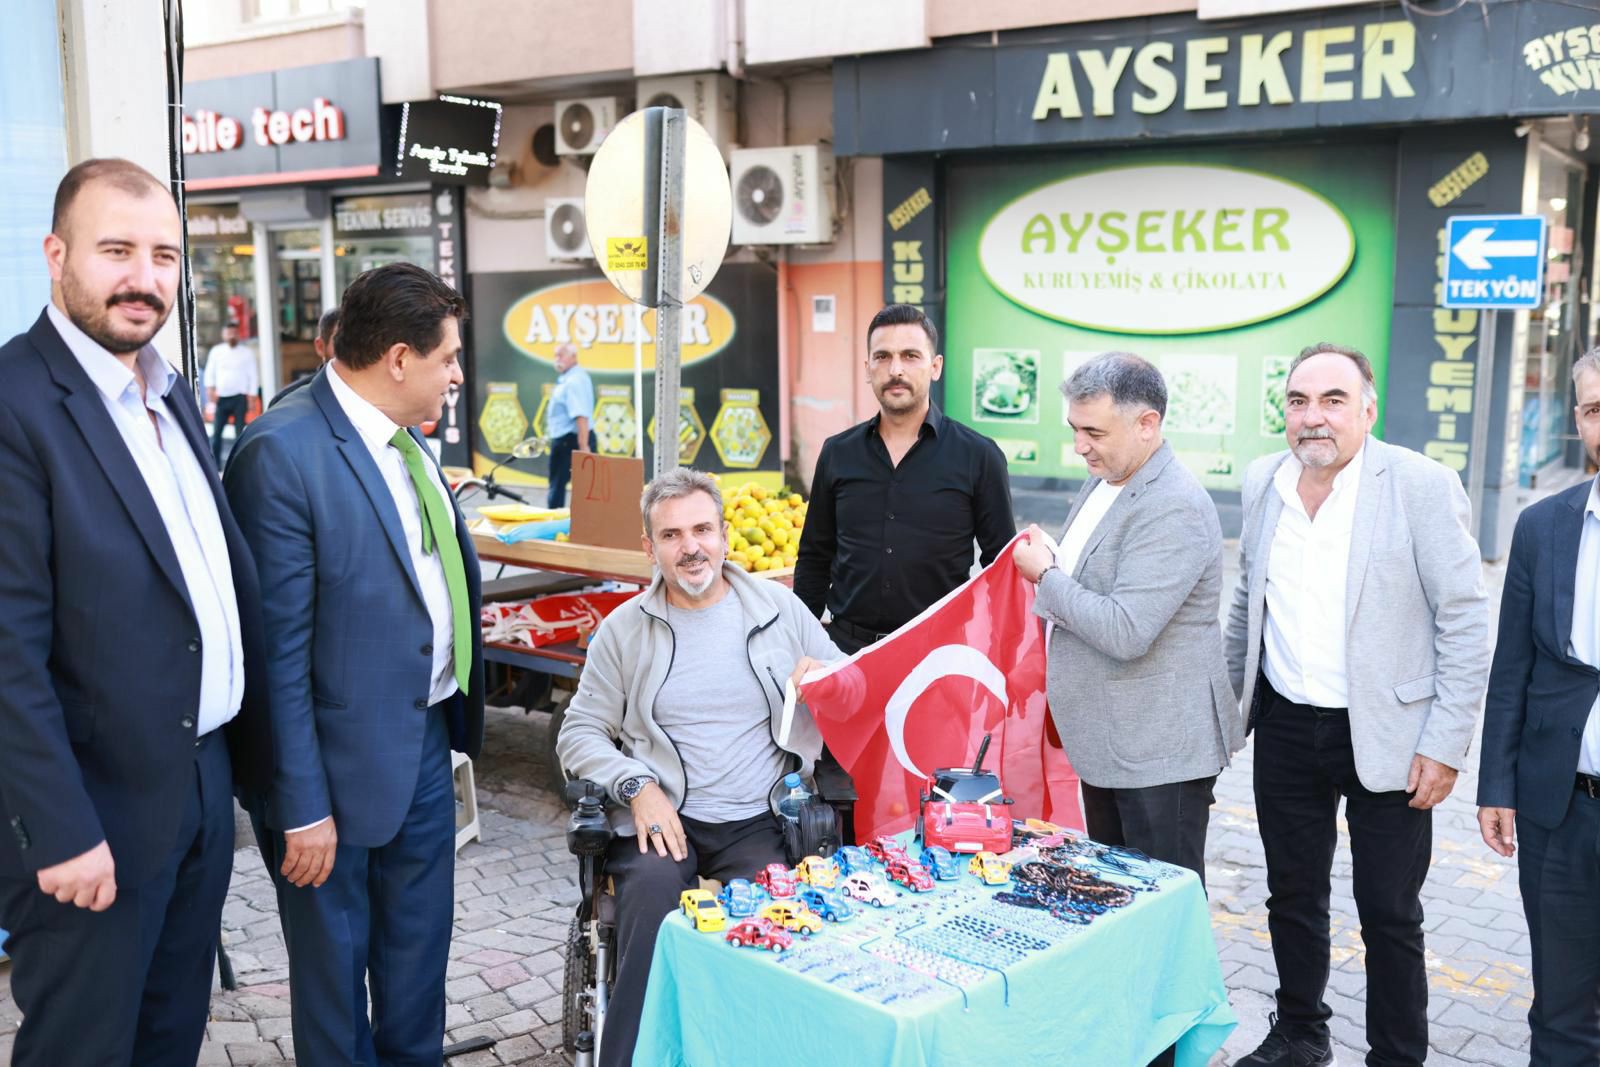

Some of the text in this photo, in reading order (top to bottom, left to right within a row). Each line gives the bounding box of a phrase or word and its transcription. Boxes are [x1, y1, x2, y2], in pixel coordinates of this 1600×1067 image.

[1032, 20, 1416, 120] AYSEKER
[252, 97, 347, 146] tech
[1021, 208, 1291, 266] AYŞEKER
[892, 240, 925, 315] KUR
[1022, 267, 1288, 294] KURUYEMİŞ & ÇİKOLATA
[1450, 275, 1537, 299] TEK YÖN
[526, 303, 712, 348] AYŞEKR
[582, 455, 612, 503] 20
